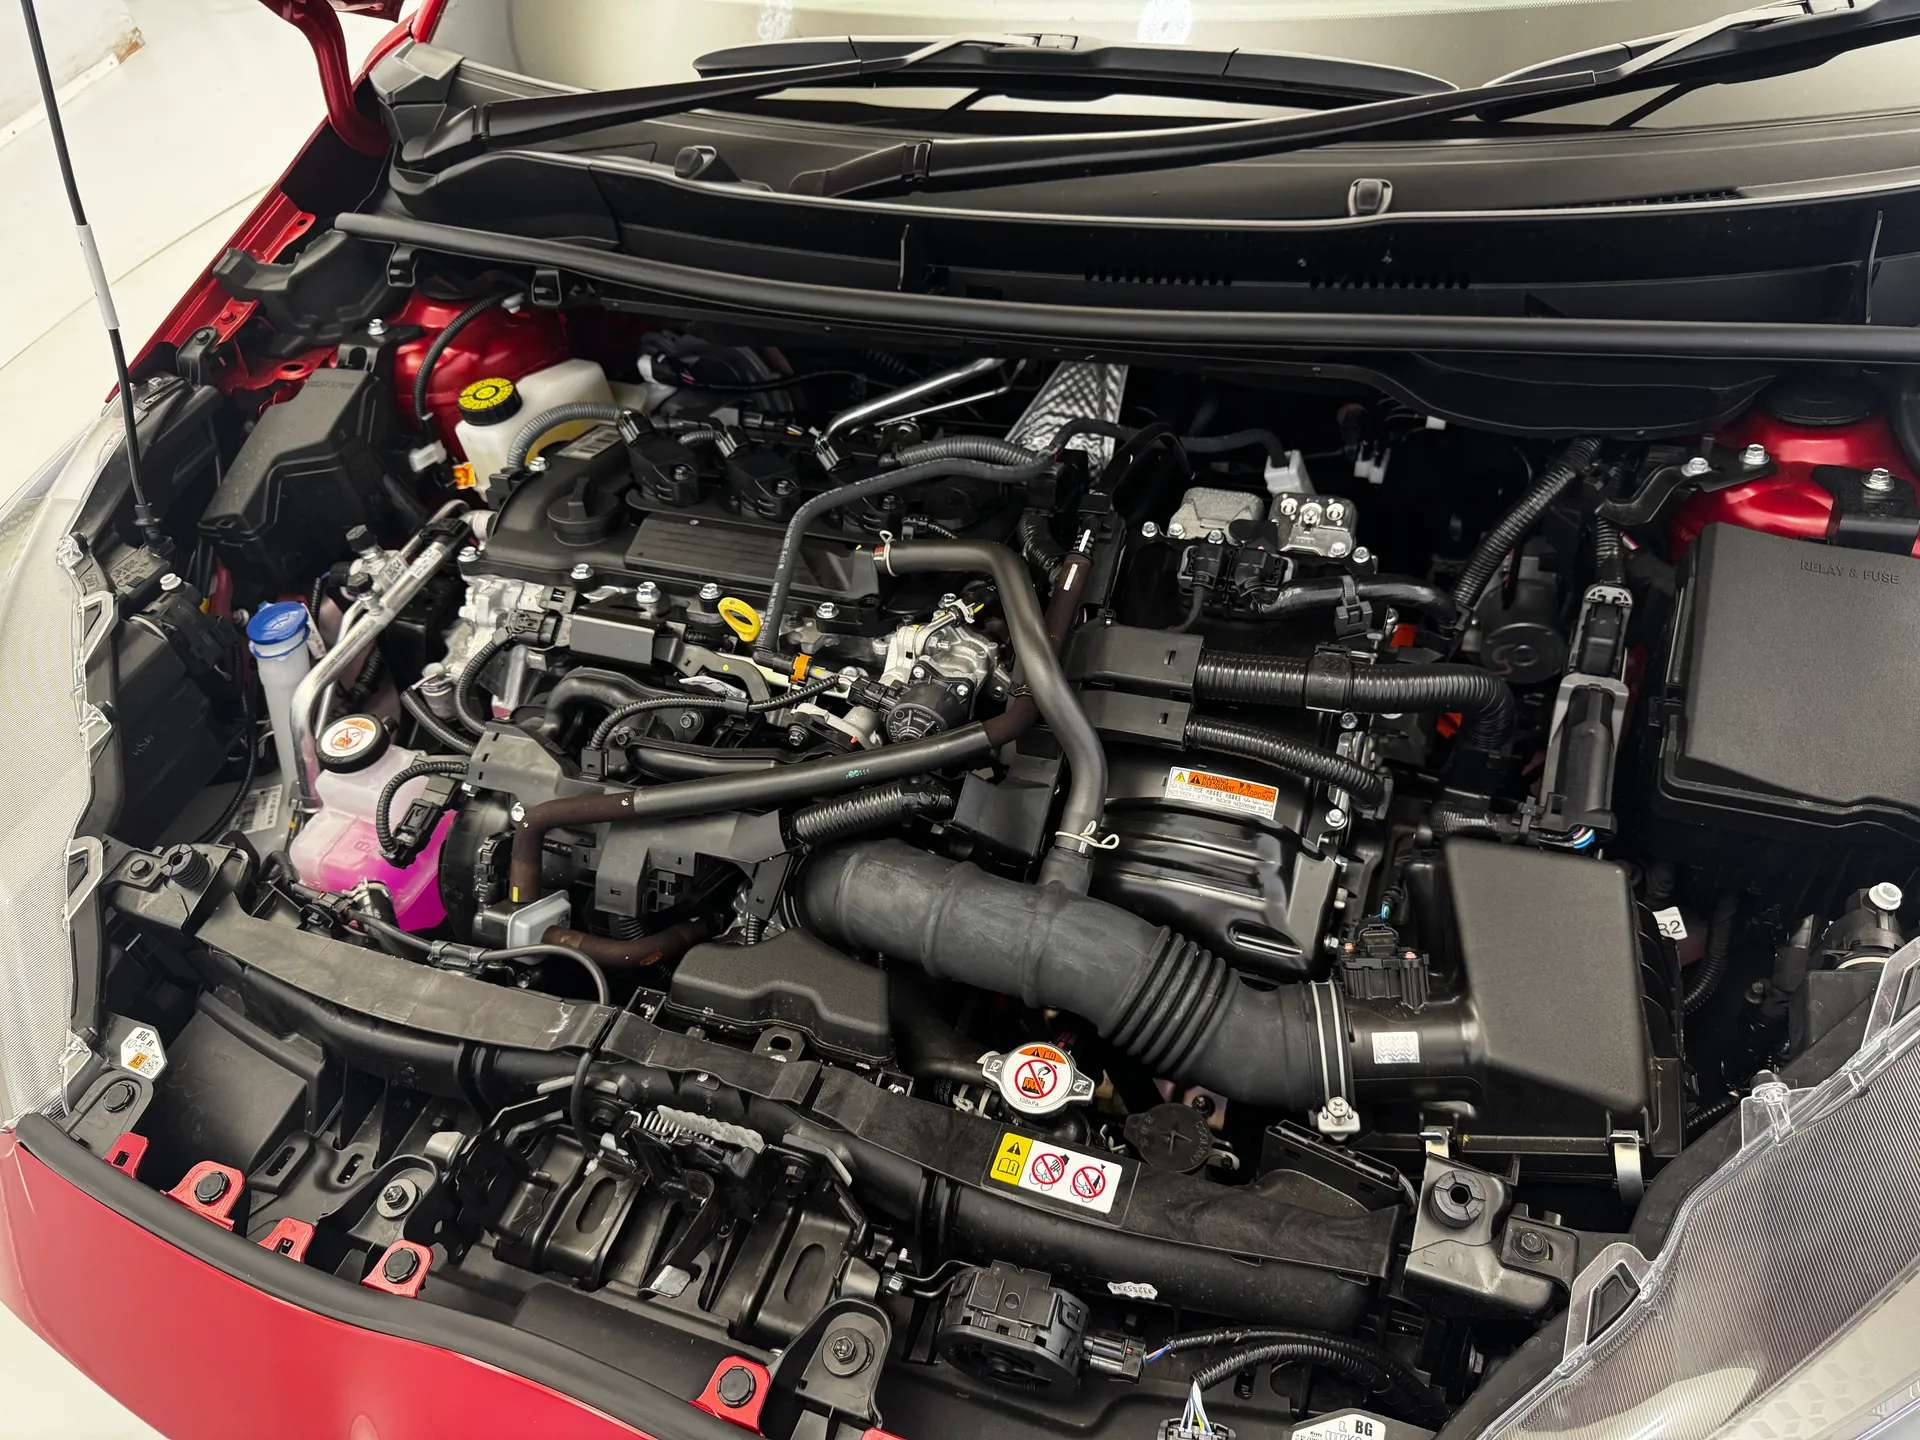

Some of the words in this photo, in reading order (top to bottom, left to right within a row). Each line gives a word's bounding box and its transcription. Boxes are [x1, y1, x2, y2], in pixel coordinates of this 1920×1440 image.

[1800, 560, 1843, 577] RELAY
[1848, 567, 1858, 578] &
[1863, 569, 1900, 585] FUSE
[1355, 1420, 1374, 1437] BG
